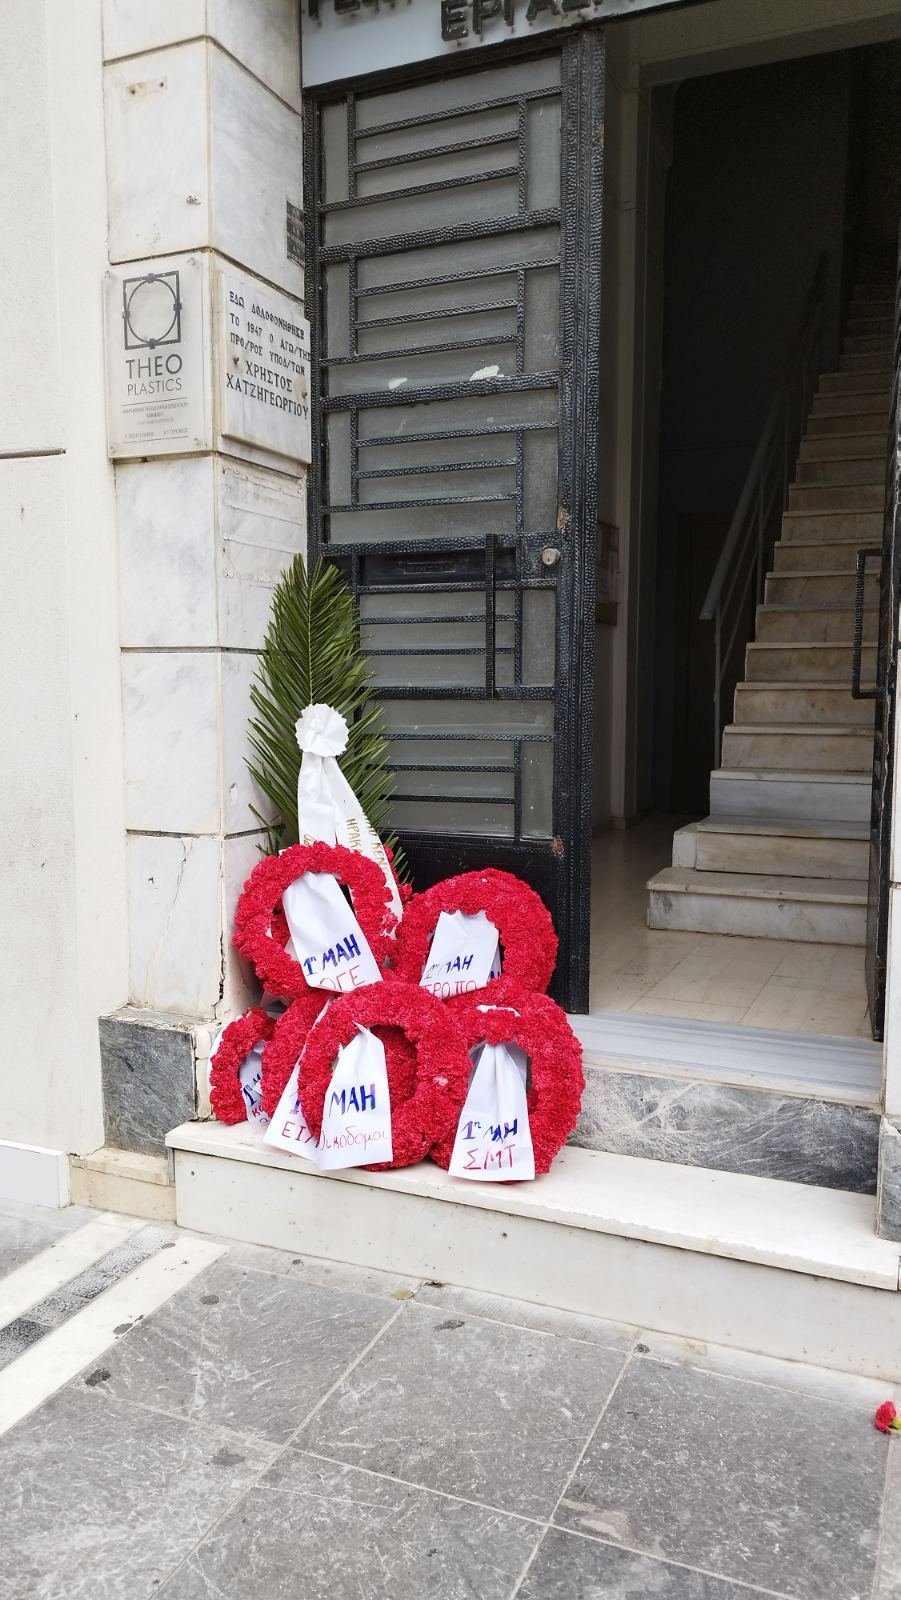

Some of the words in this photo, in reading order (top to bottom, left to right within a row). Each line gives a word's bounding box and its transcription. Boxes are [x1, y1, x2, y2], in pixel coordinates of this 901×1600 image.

[229, 290, 245, 309] ΕΔΩ
[229, 312, 240, 327] ΤΟ
[247, 321, 263, 337] 1947
[125, 353, 183, 380] THEO
[245, 359, 293, 393] ΧΡΗΣΤΟΣ
[127, 377, 183, 398] PLASTICS
[226, 372, 309, 420] ΧΑΤΖΗΓΕΩΡΓΙΟΥ
[345, 818, 364, 853] ΗΡΑΚ
[322, 933, 361, 971] ΜΑΗ
[328, 1083, 376, 1118] ΜΑΗ
[462, 1144, 516, 1170] ΣΜΤ
